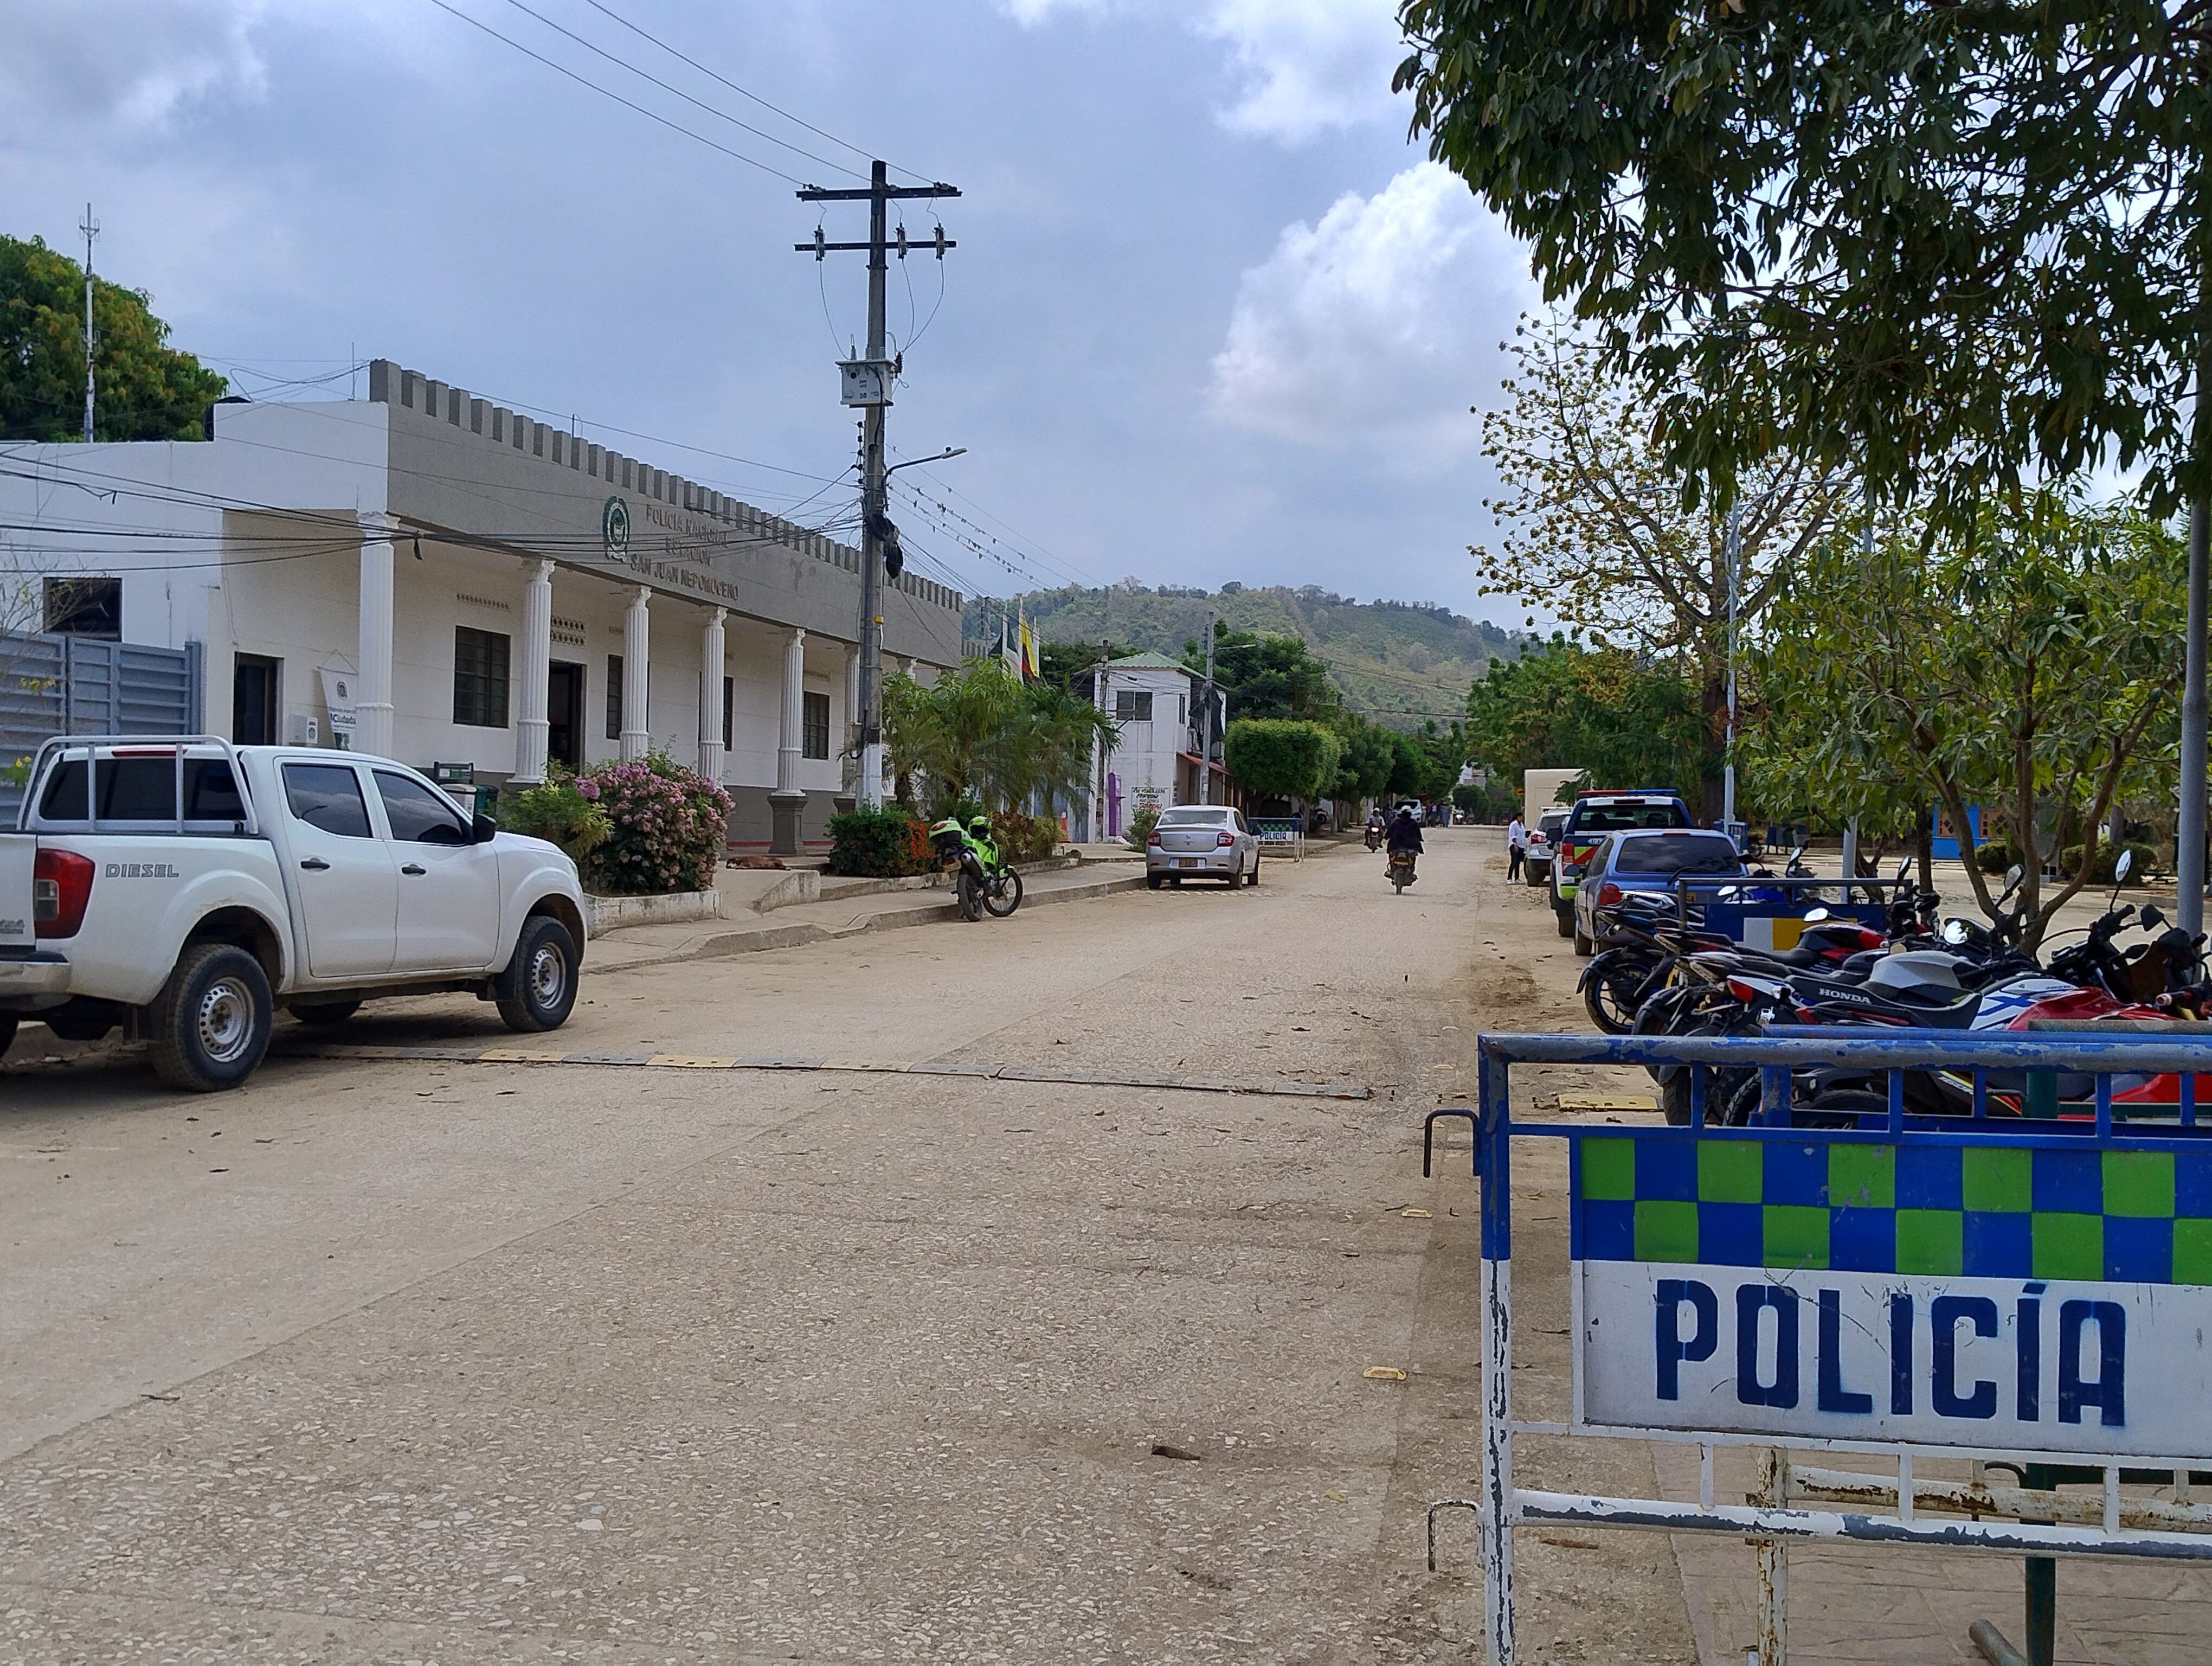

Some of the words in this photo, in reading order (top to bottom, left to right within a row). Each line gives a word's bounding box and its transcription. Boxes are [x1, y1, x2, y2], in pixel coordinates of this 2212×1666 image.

[631, 553, 651, 575] SAN
[654, 562, 678, 584] JUAN
[681, 569, 738, 601] NEPOMUCENO
[105, 863, 179, 878] DIESEL
[1818, 988, 1872, 1004] HONDA
[1656, 1279, 2126, 1426] POLICÍA
